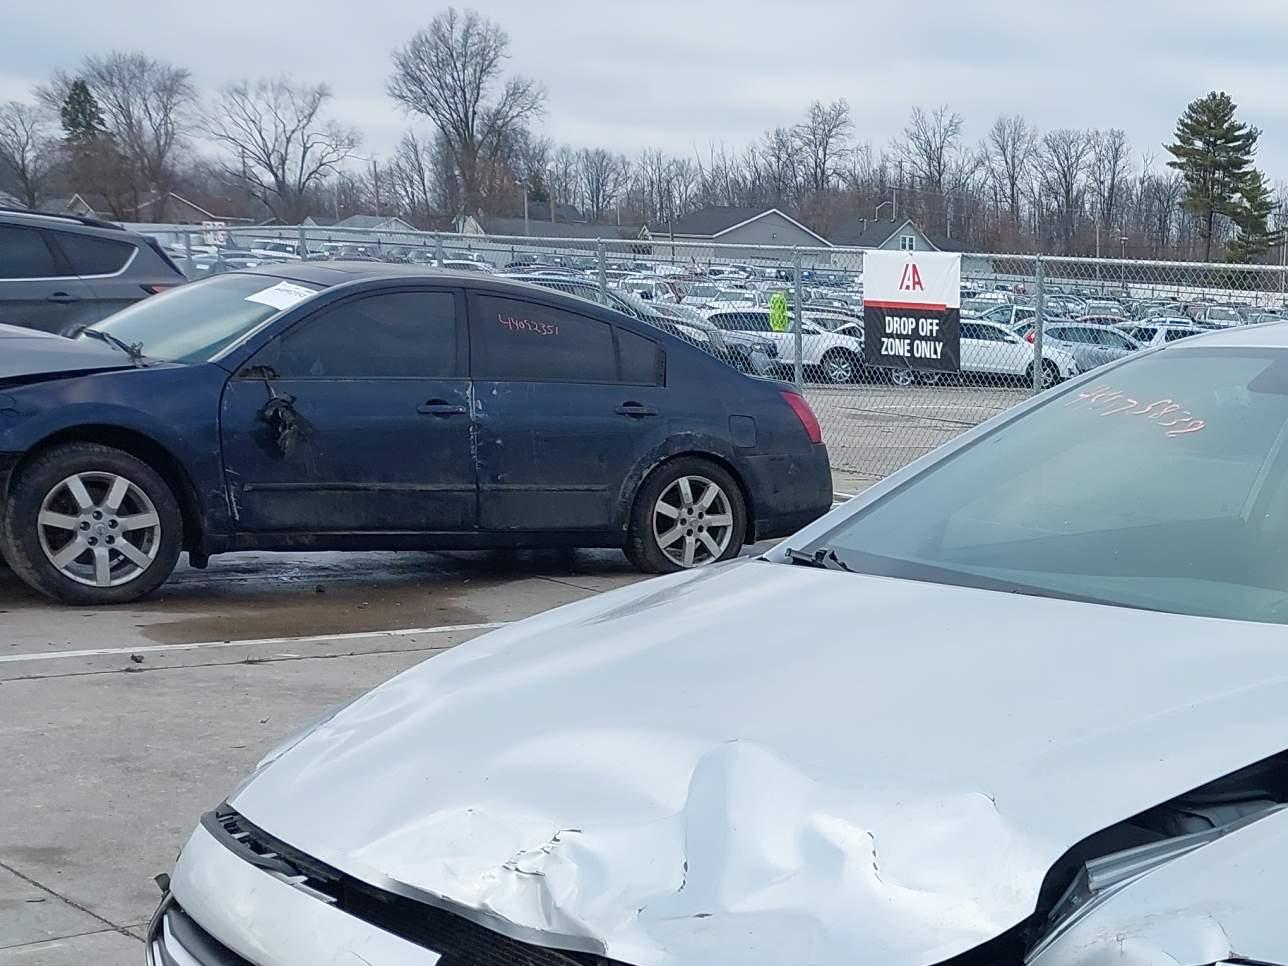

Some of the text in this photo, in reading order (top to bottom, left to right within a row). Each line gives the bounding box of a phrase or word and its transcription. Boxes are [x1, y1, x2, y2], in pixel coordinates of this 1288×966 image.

[885, 316, 939, 336] DROP OFF
[881, 338, 943, 358] ZONE ONLY
